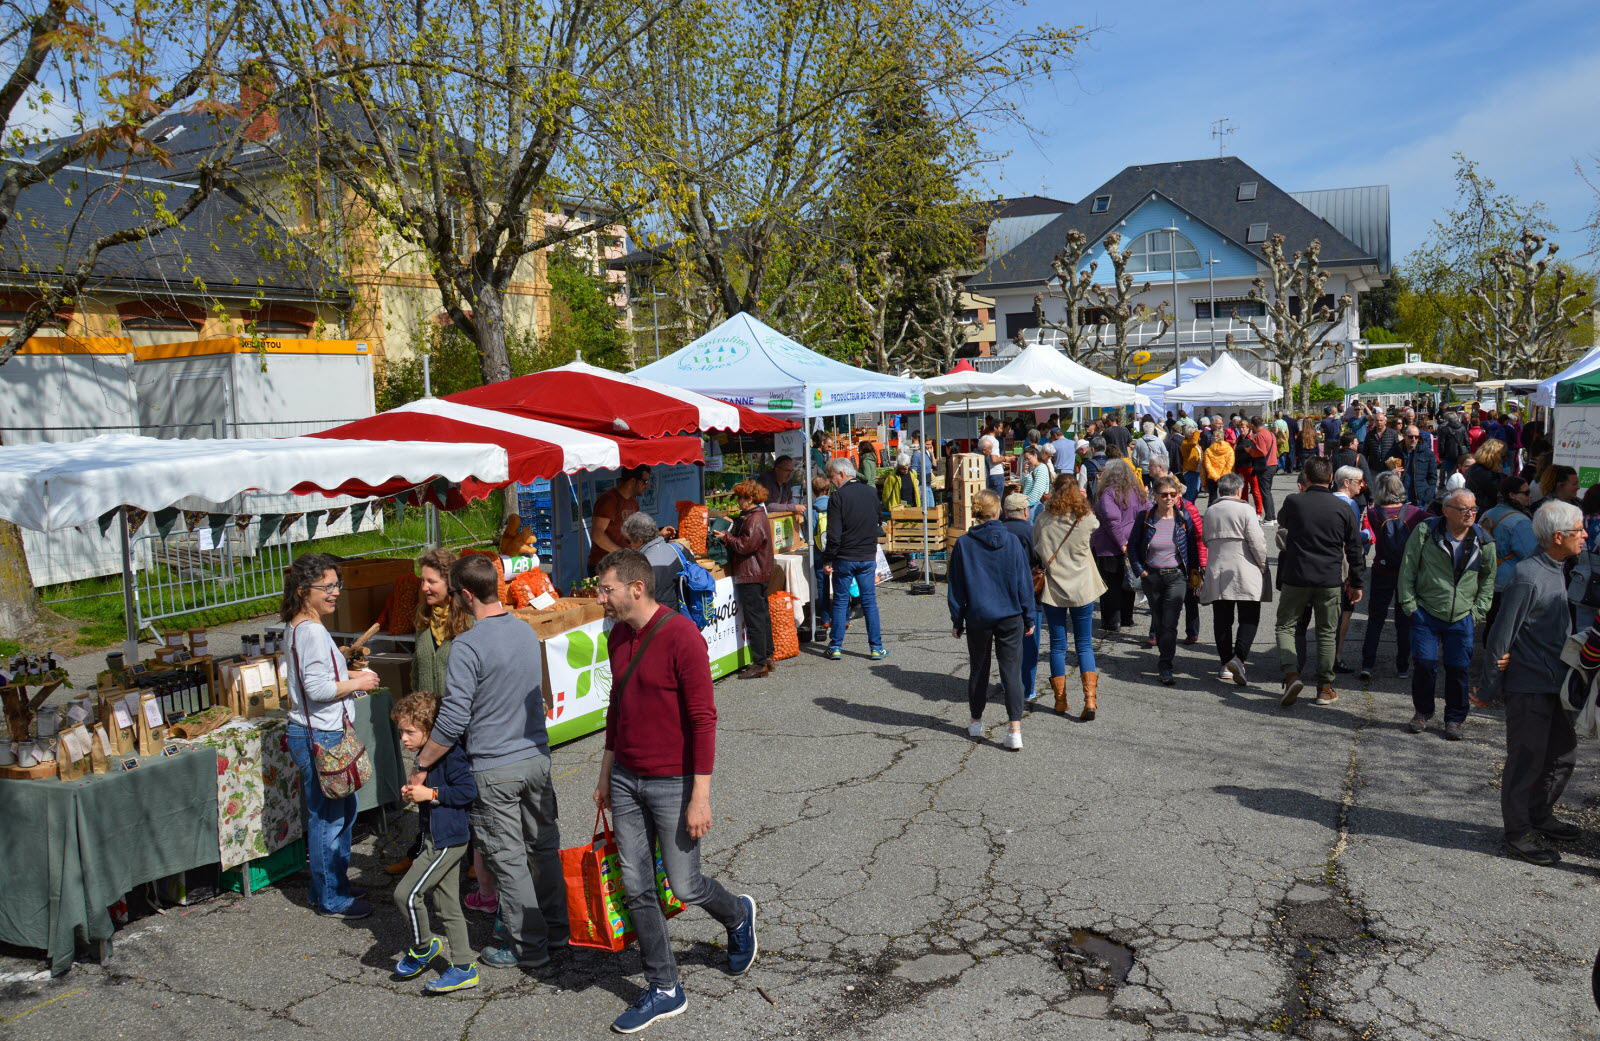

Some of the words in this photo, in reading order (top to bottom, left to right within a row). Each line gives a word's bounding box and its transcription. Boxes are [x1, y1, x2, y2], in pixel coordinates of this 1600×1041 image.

[696, 336, 749, 348] Spiruline
[700, 362, 732, 372] Alpes
[830, 392, 860, 402] PRODUCTEUR
[512, 557, 531, 573] AB
